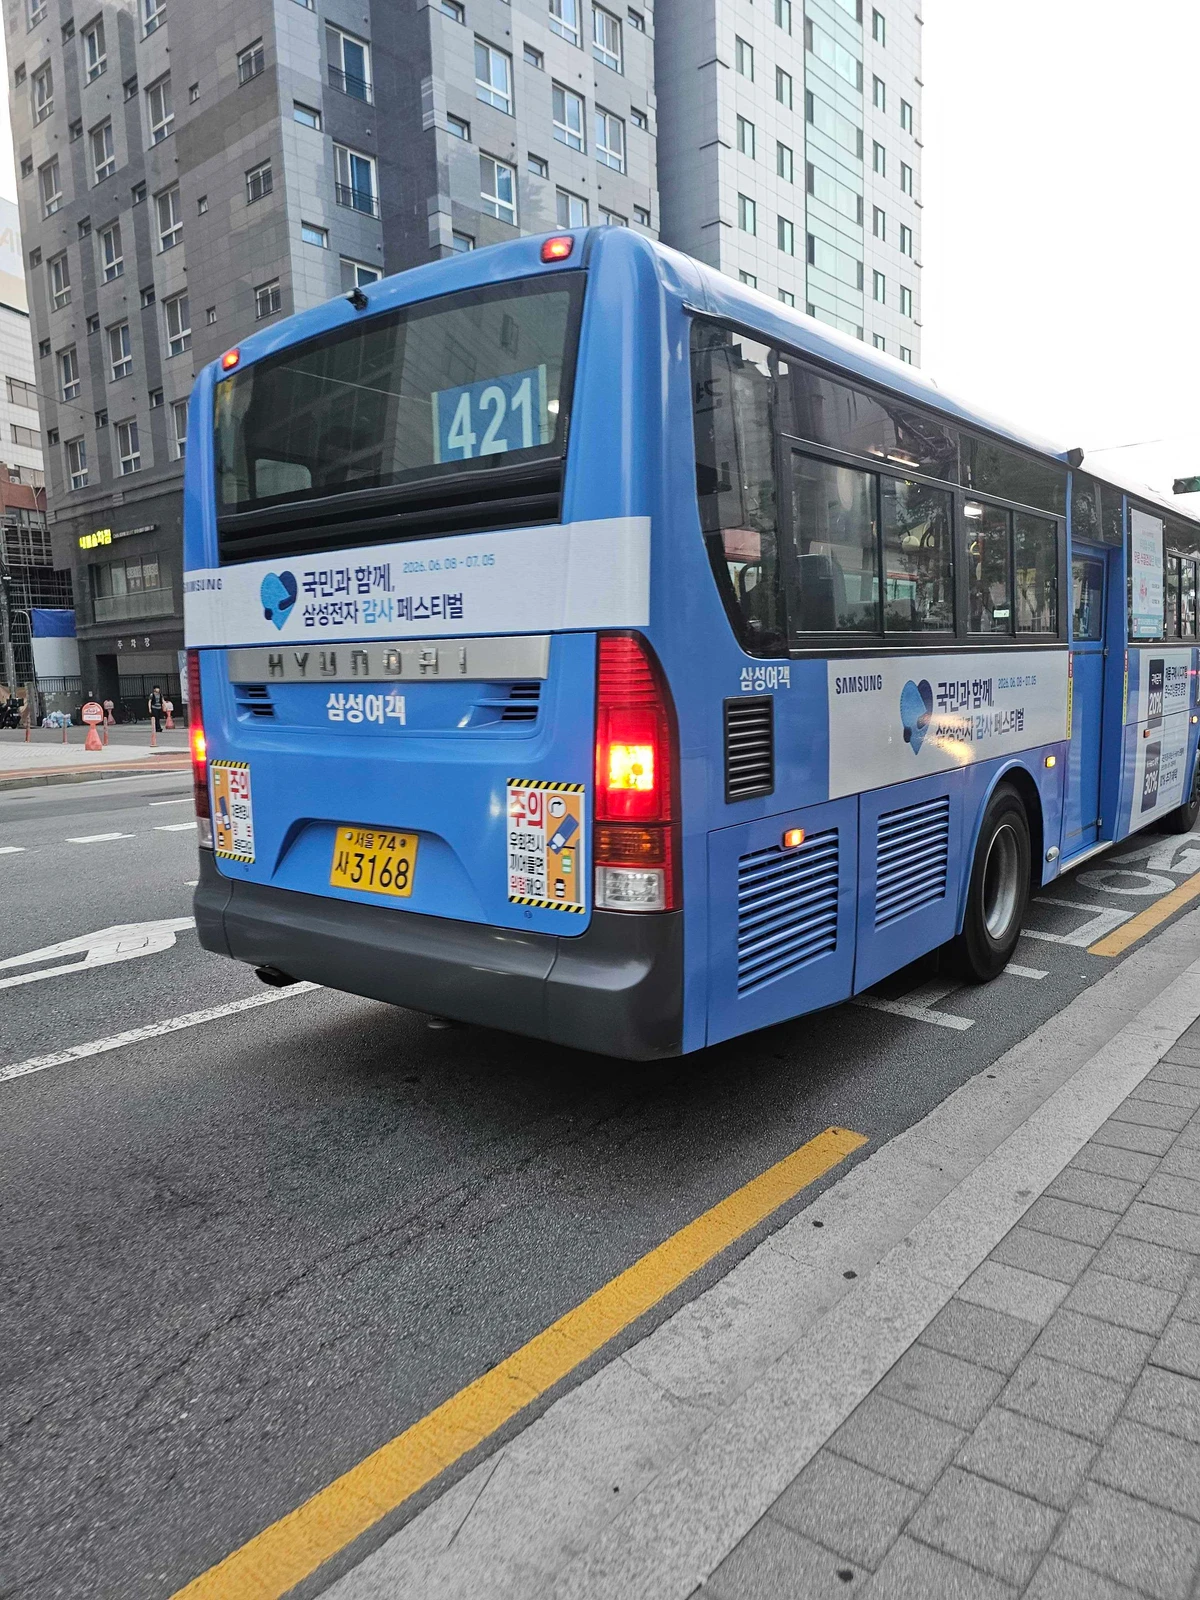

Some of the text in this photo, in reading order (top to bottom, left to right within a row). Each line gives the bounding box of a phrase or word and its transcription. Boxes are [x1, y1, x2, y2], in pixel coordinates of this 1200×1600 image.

[448, 378, 533, 459] 421
[302, 567, 351, 598] 국민과
[302, 593, 464, 627] 삼성전자 감사 페스티벌
[268, 646, 467, 677] HYUNDAI
[740, 666, 791, 691] 삼성여객
[835, 674, 882, 695] SAMSUNG
[326, 693, 406, 725] 삼성여객
[936, 680, 970, 713] 국민과
[1149, 692, 1162, 715] 20%
[976, 713, 993, 740] 감사
[994, 707, 1025, 735] 페스티벌
[230, 770, 250, 801] 주의
[1144, 770, 1158, 796] 30%
[510, 790, 544, 829] 주의
[354, 832, 397, 851] 서울 74
[510, 832, 544, 853] 우회전시
[510, 853, 544, 875] 끼어들면
[510, 875, 544, 897] 위험해요
